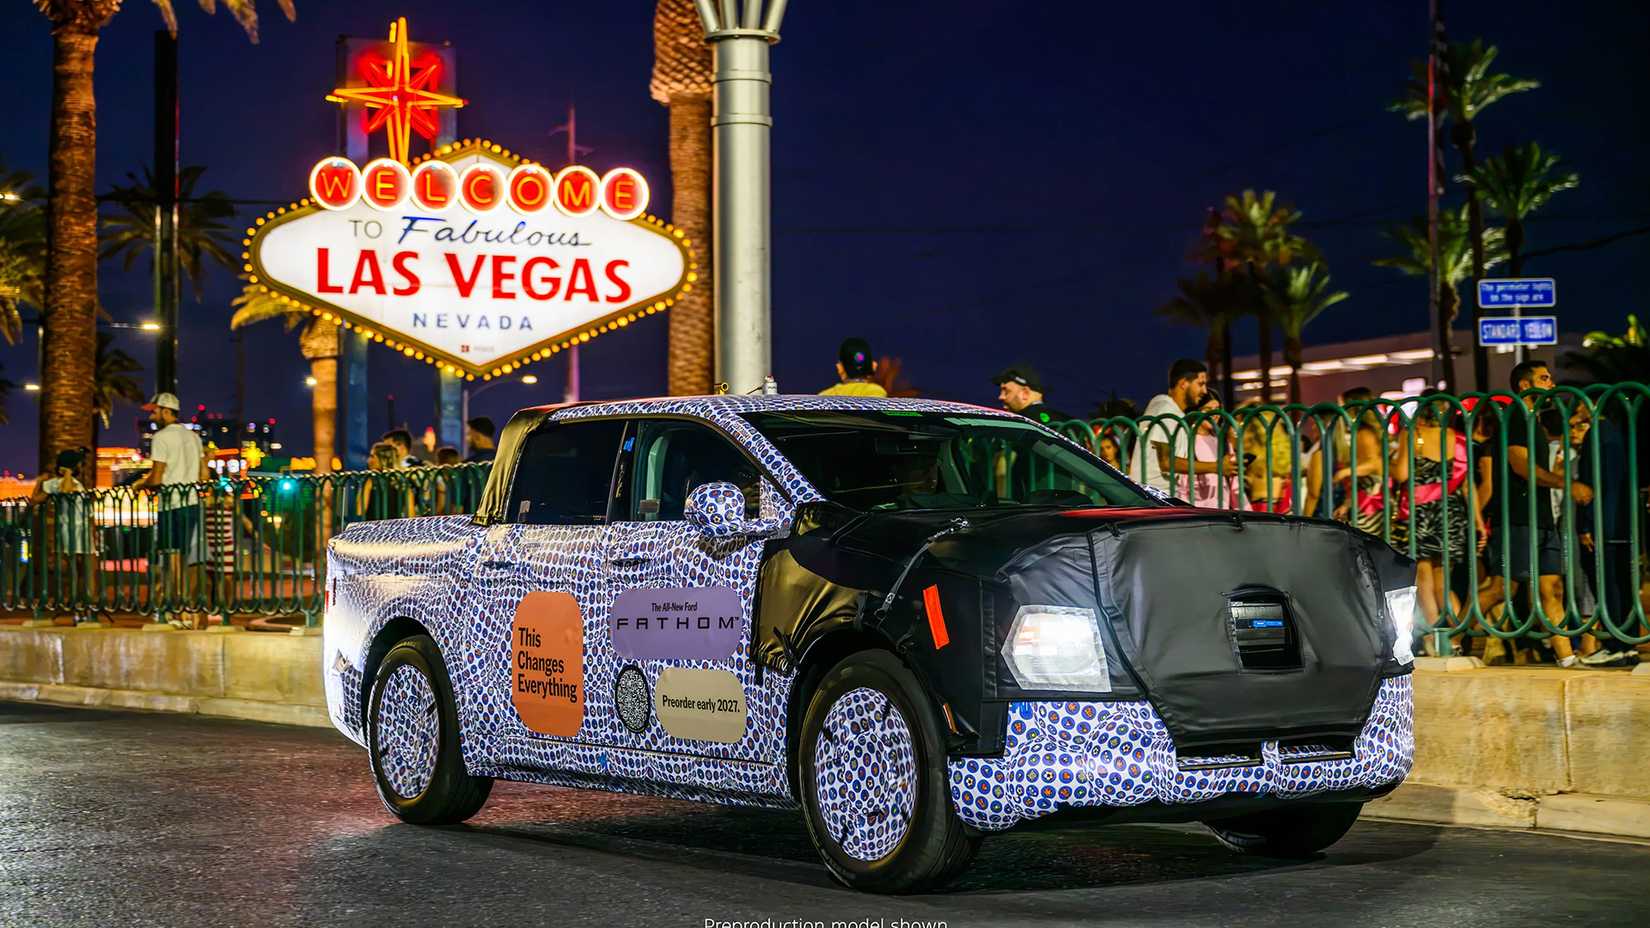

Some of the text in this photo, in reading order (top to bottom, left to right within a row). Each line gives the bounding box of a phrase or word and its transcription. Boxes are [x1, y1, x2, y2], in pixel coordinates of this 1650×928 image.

[321, 171, 636, 211] WELCOME
[349, 216, 591, 247] TO Fabulous
[316, 247, 632, 303] LAS VEGAS
[413, 312, 533, 331] NEVADA
[651, 602, 698, 612] The All-New Ford
[518, 627, 541, 648] This
[518, 651, 564, 676] Changes
[518, 673, 577, 703] Everything
[662, 695, 740, 713] Preorder early 2027.
